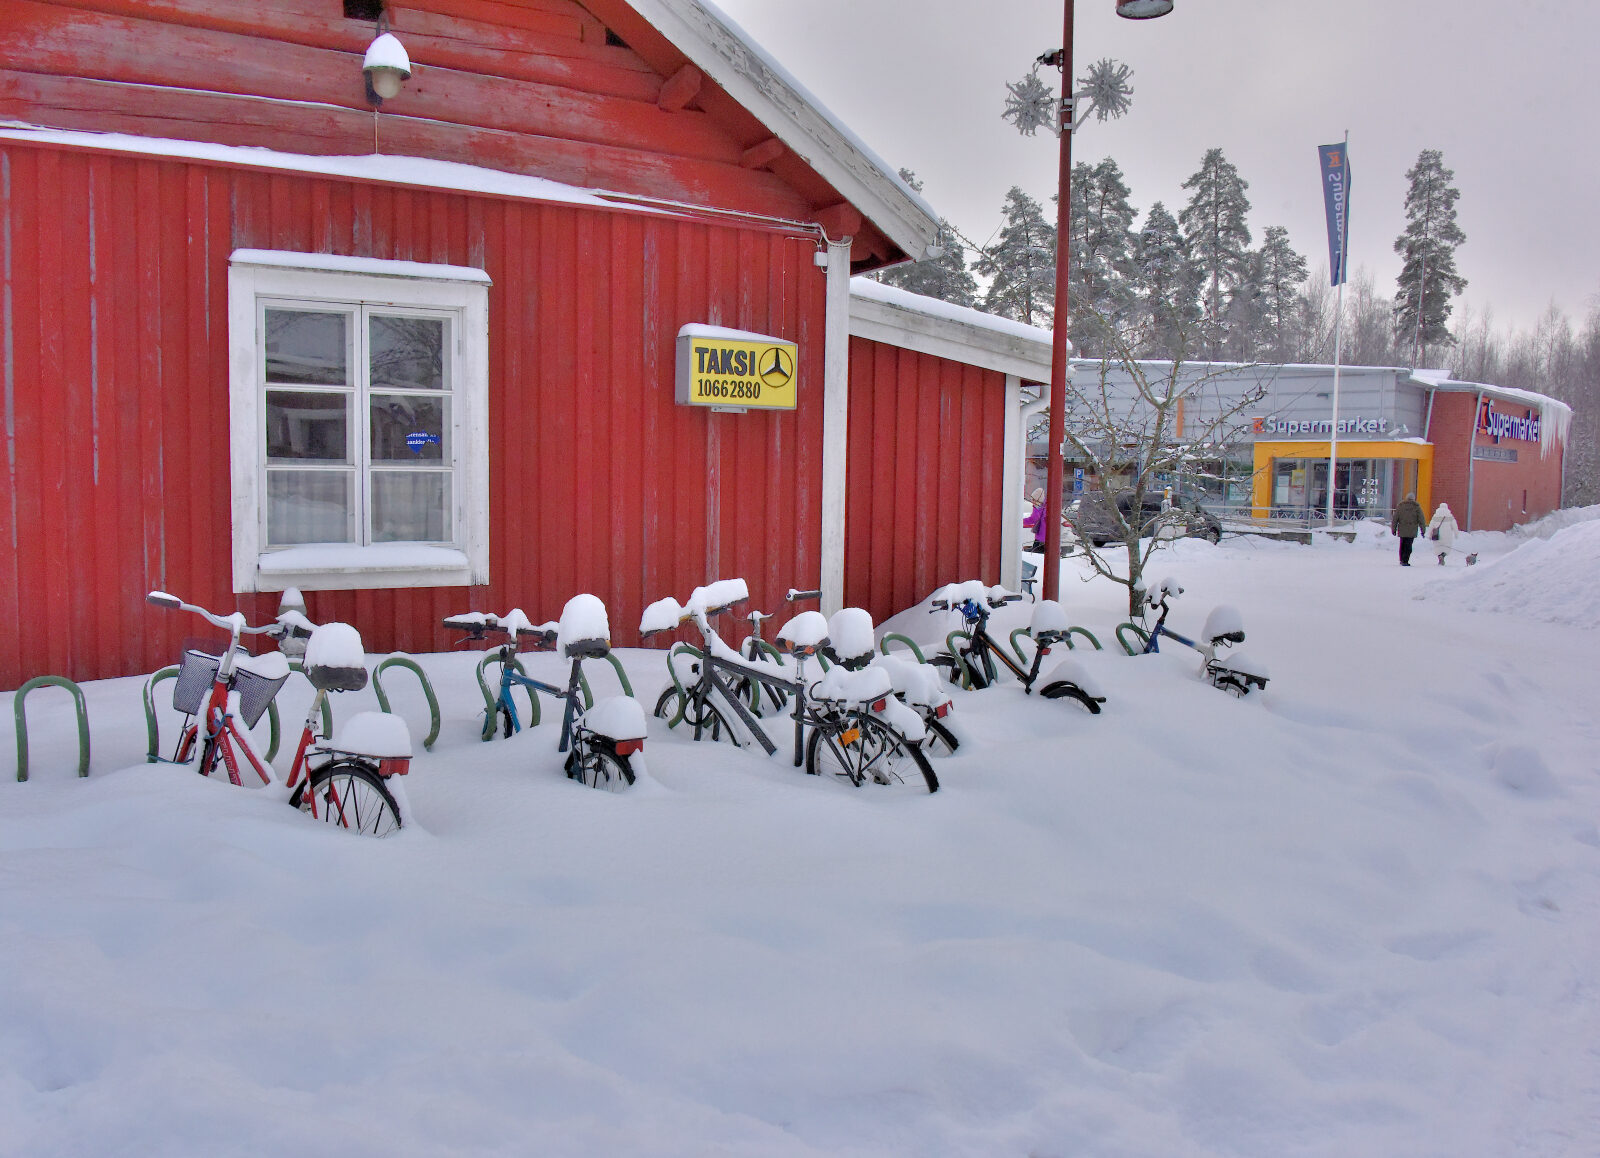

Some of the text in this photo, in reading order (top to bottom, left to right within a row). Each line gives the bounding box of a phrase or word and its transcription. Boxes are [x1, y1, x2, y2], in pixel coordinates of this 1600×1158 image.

[694, 346, 756, 377] TAKSI
[697, 378, 761, 399] 10662880
[1266, 415, 1388, 437] Supermarket
[1486, 399, 1541, 445] Supermarket
